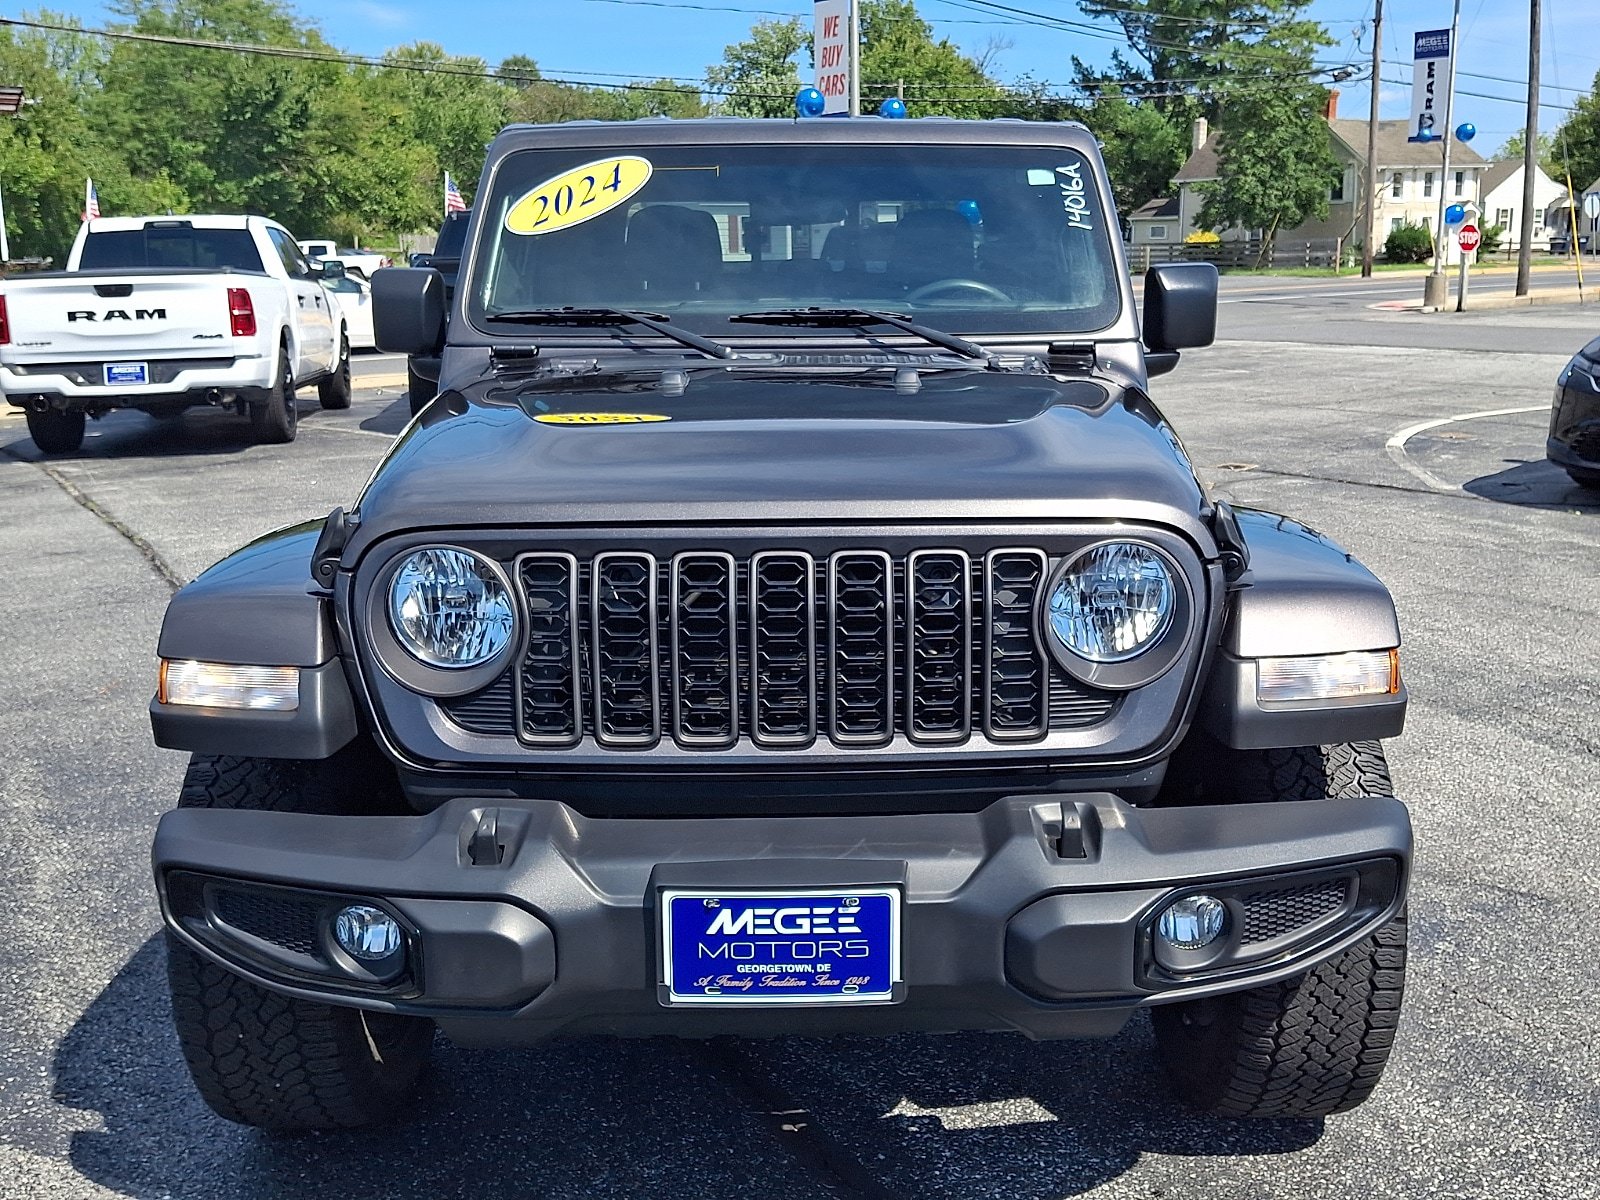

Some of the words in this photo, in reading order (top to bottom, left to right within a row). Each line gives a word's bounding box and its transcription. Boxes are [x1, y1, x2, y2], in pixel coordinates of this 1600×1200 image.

[824, 16, 840, 39] WE
[1416, 34, 1448, 48] MEGEE
[822, 44, 843, 68] BUY
[819, 73, 846, 97] CARS
[1425, 61, 1436, 111] RAM
[532, 162, 622, 228] 2024
[1055, 161, 1093, 231] 14016A
[1459, 232, 1479, 244] STOP
[67, 308, 167, 323] RAM
[706, 907, 862, 935] MEGEE
[698, 940, 869, 959] MOTORS
[736, 964, 815, 974] GEORGETOWN,
[816, 963, 831, 973] DE
[693, 975, 714, 987] A
[713, 974, 753, 991] Family
[758, 974, 807, 987] Tradition
[811, 973, 841, 986] Since
